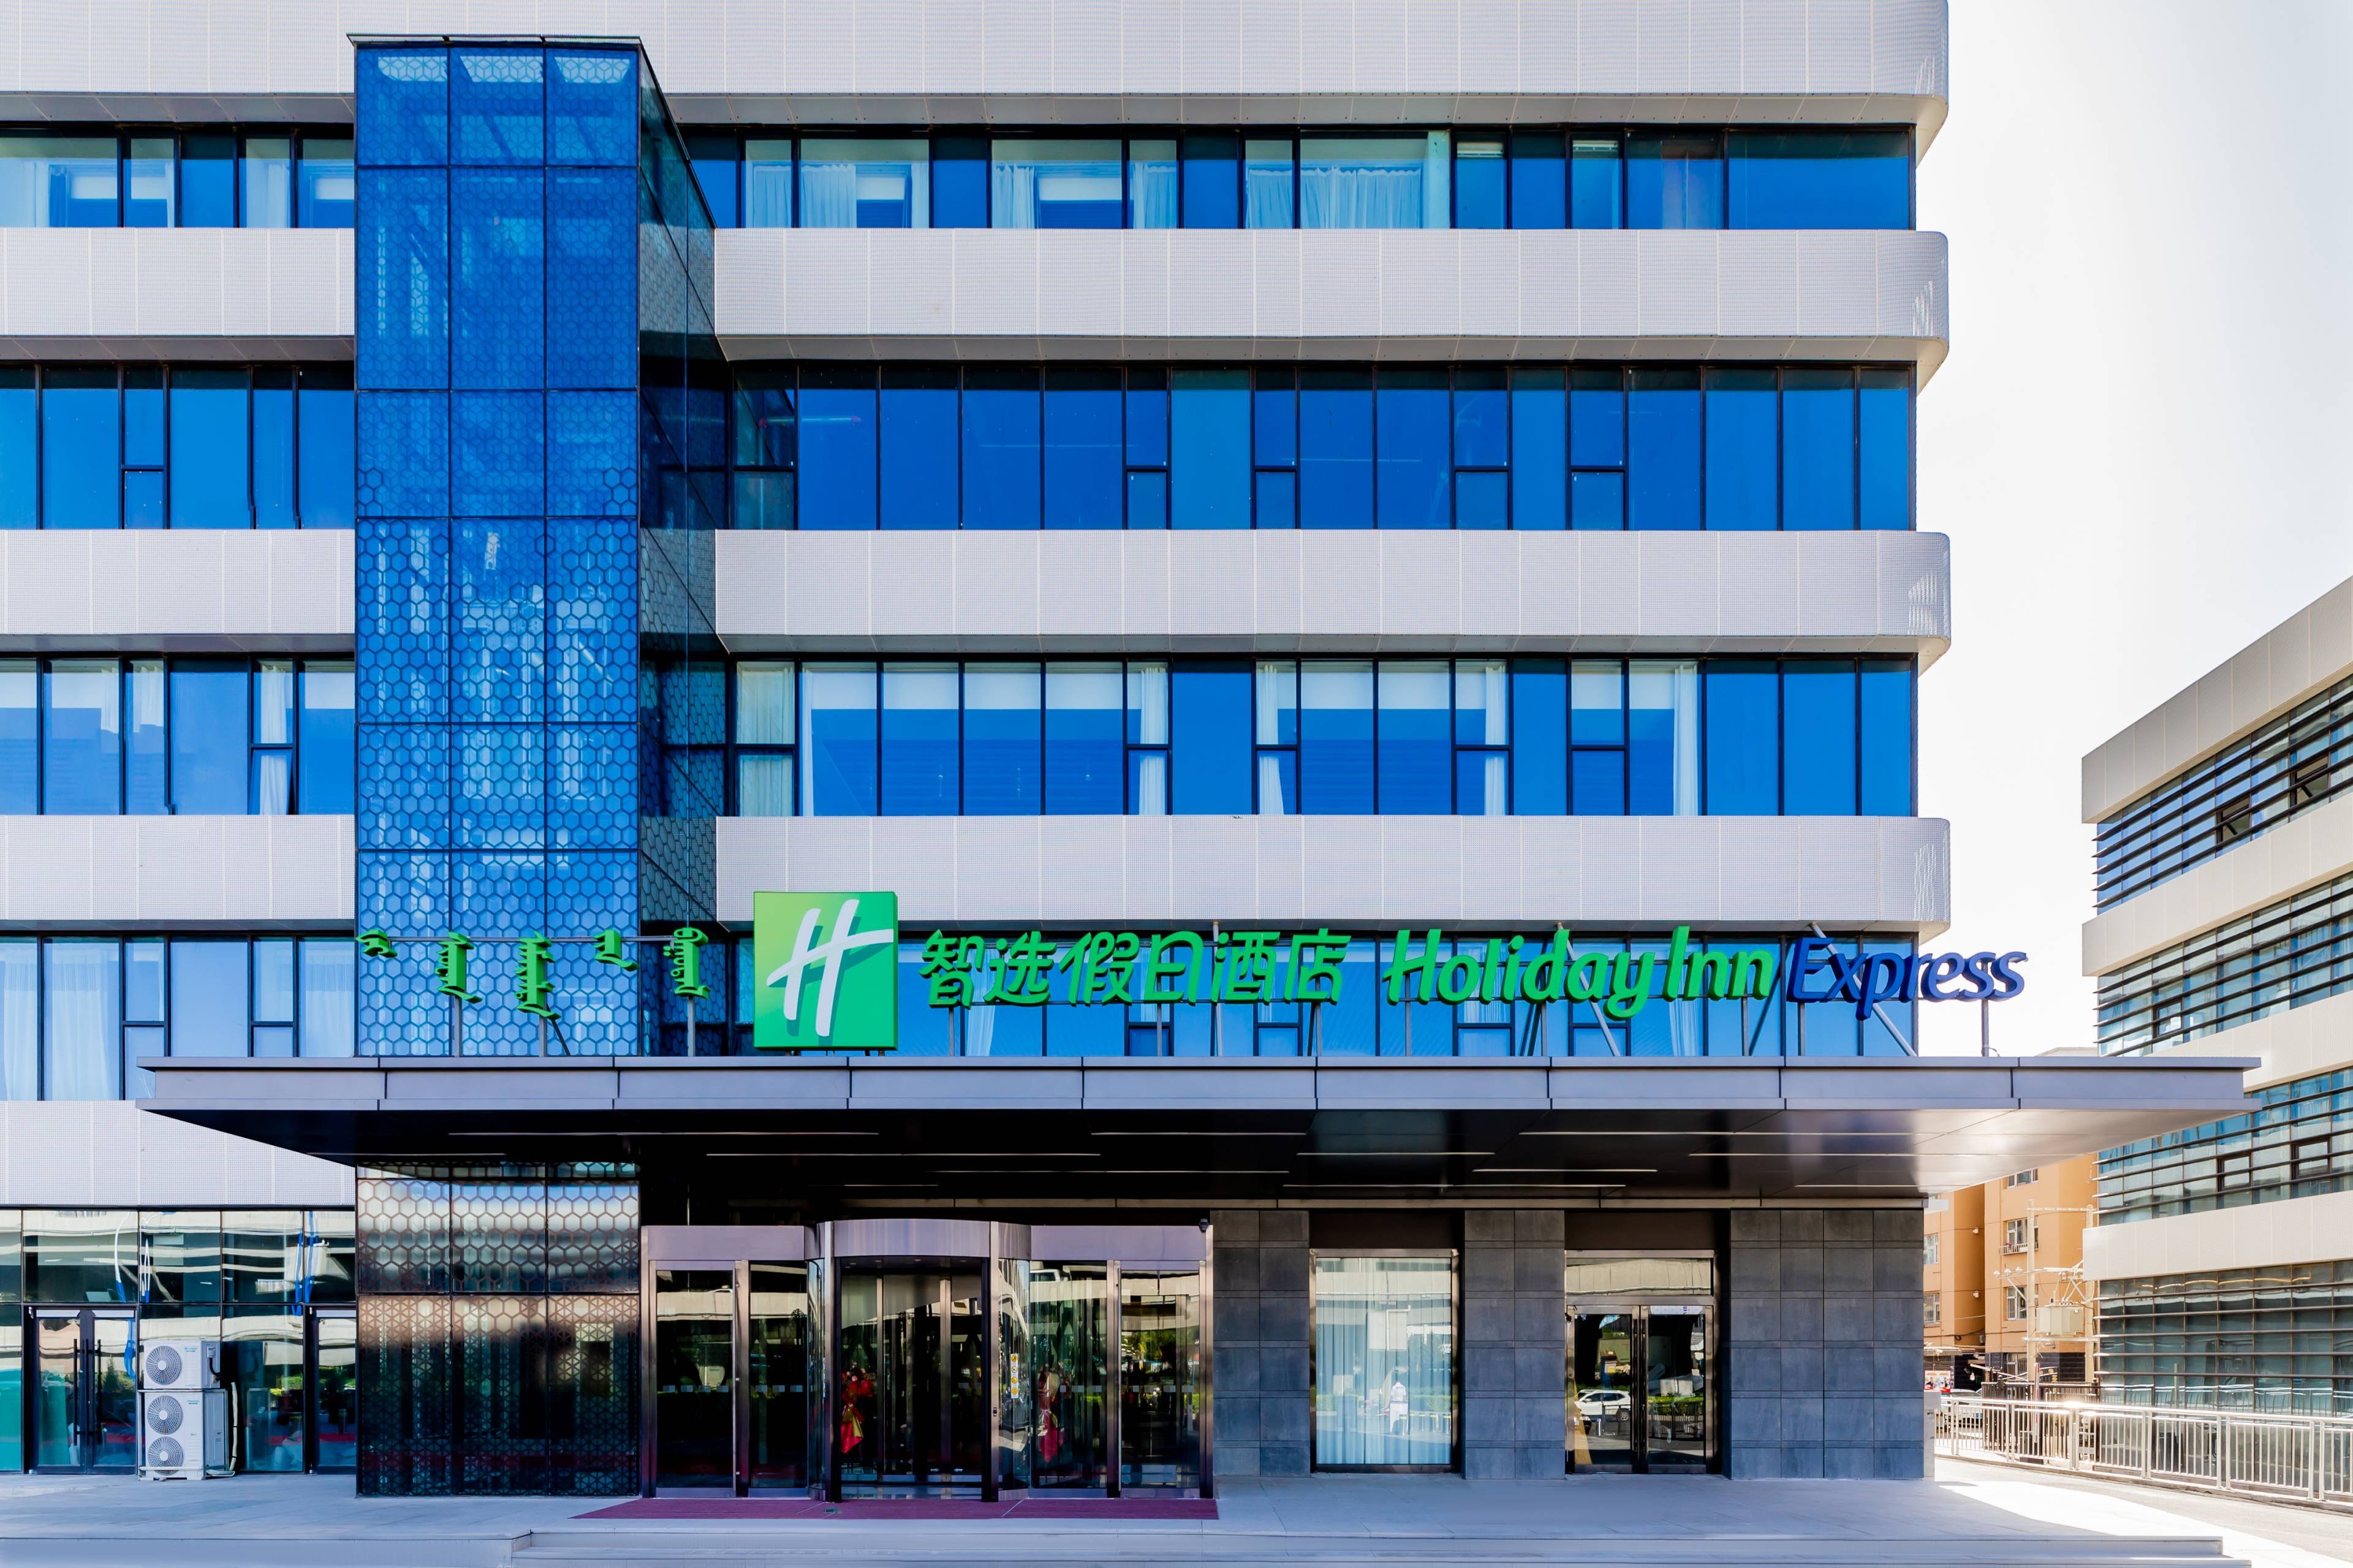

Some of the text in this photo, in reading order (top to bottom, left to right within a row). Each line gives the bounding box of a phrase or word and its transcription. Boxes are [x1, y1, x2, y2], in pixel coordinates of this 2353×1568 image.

[919, 928, 1352, 1009] 智选假日酒店
[1383, 925, 2028, 1021] Holiday Inn Express
